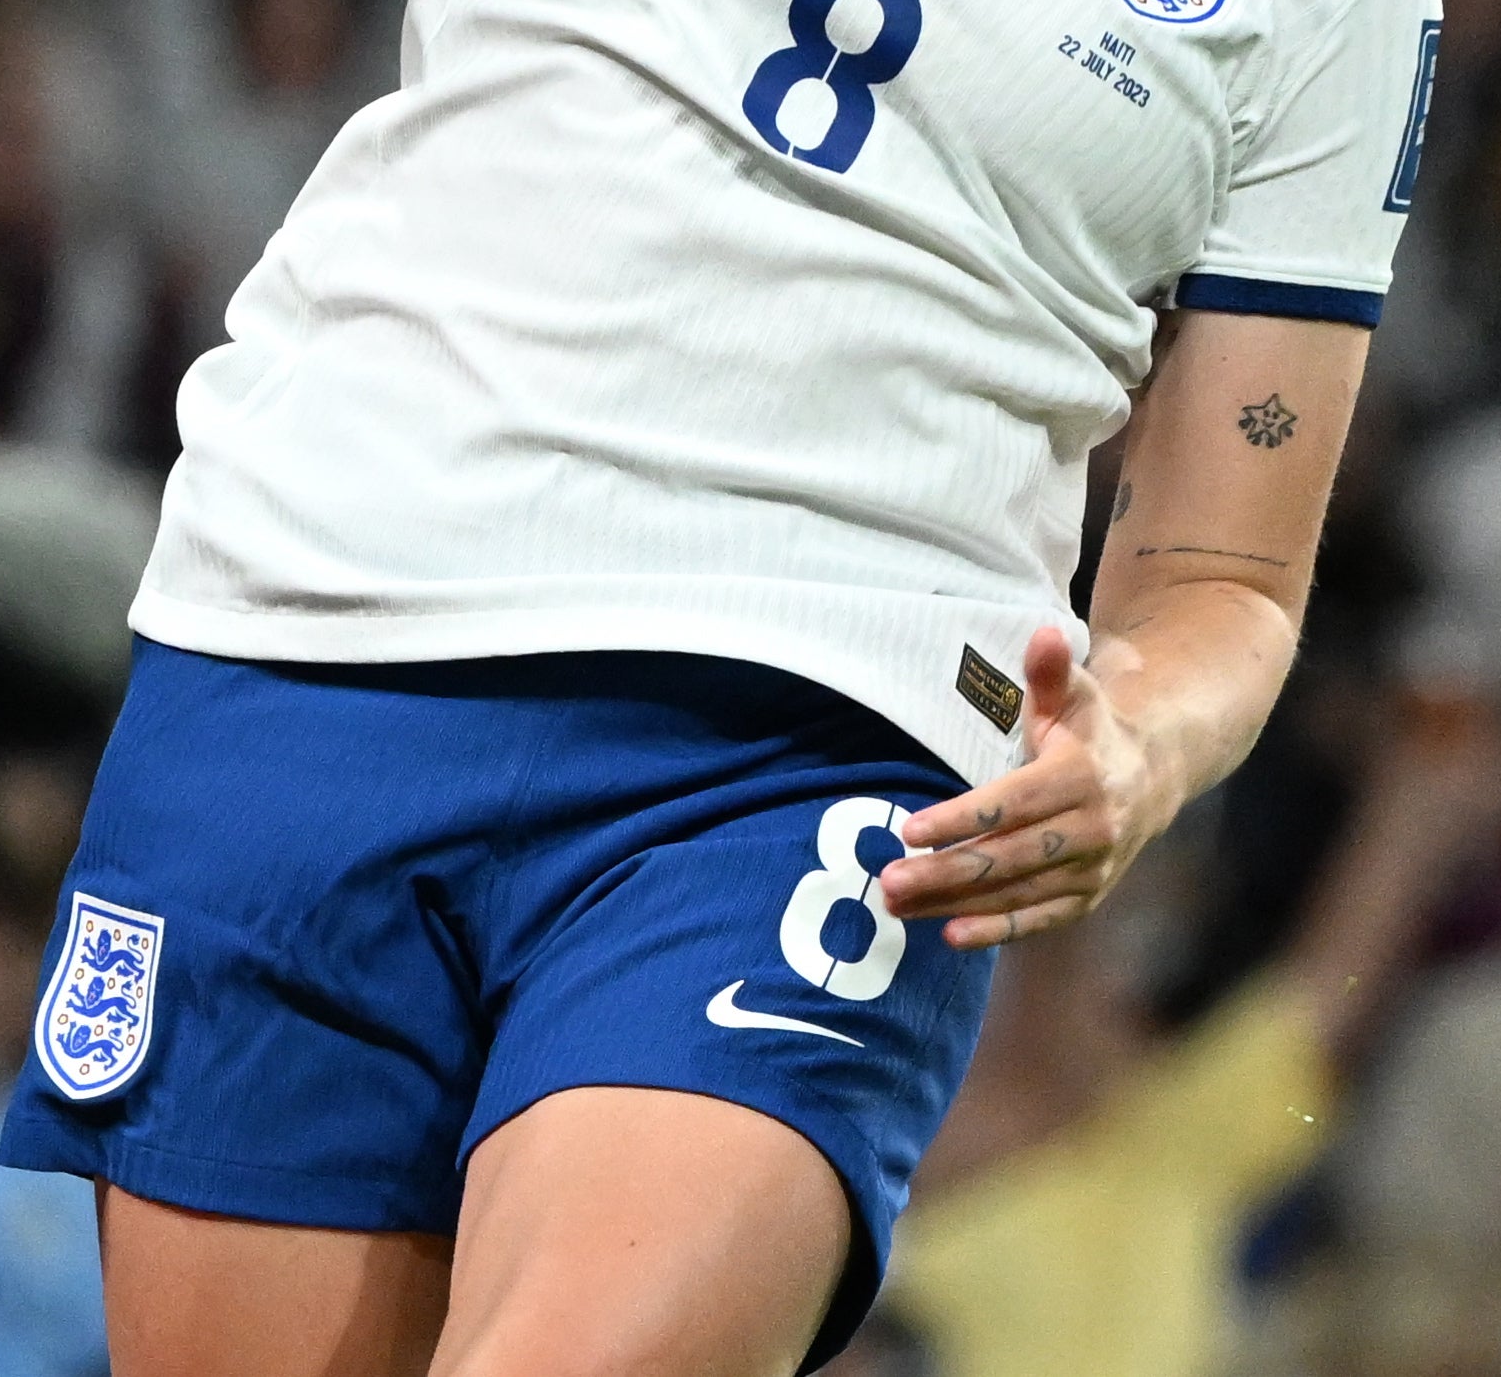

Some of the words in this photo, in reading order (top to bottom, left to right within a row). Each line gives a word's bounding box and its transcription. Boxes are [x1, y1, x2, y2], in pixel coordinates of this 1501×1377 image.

[1058, 35, 1081, 60] 22
[1081, 50, 1116, 81] JULY
[1113, 73, 1151, 108] 2023
[1099, 31, 1136, 66] HAITI
[780, 797, 934, 1001] 8
